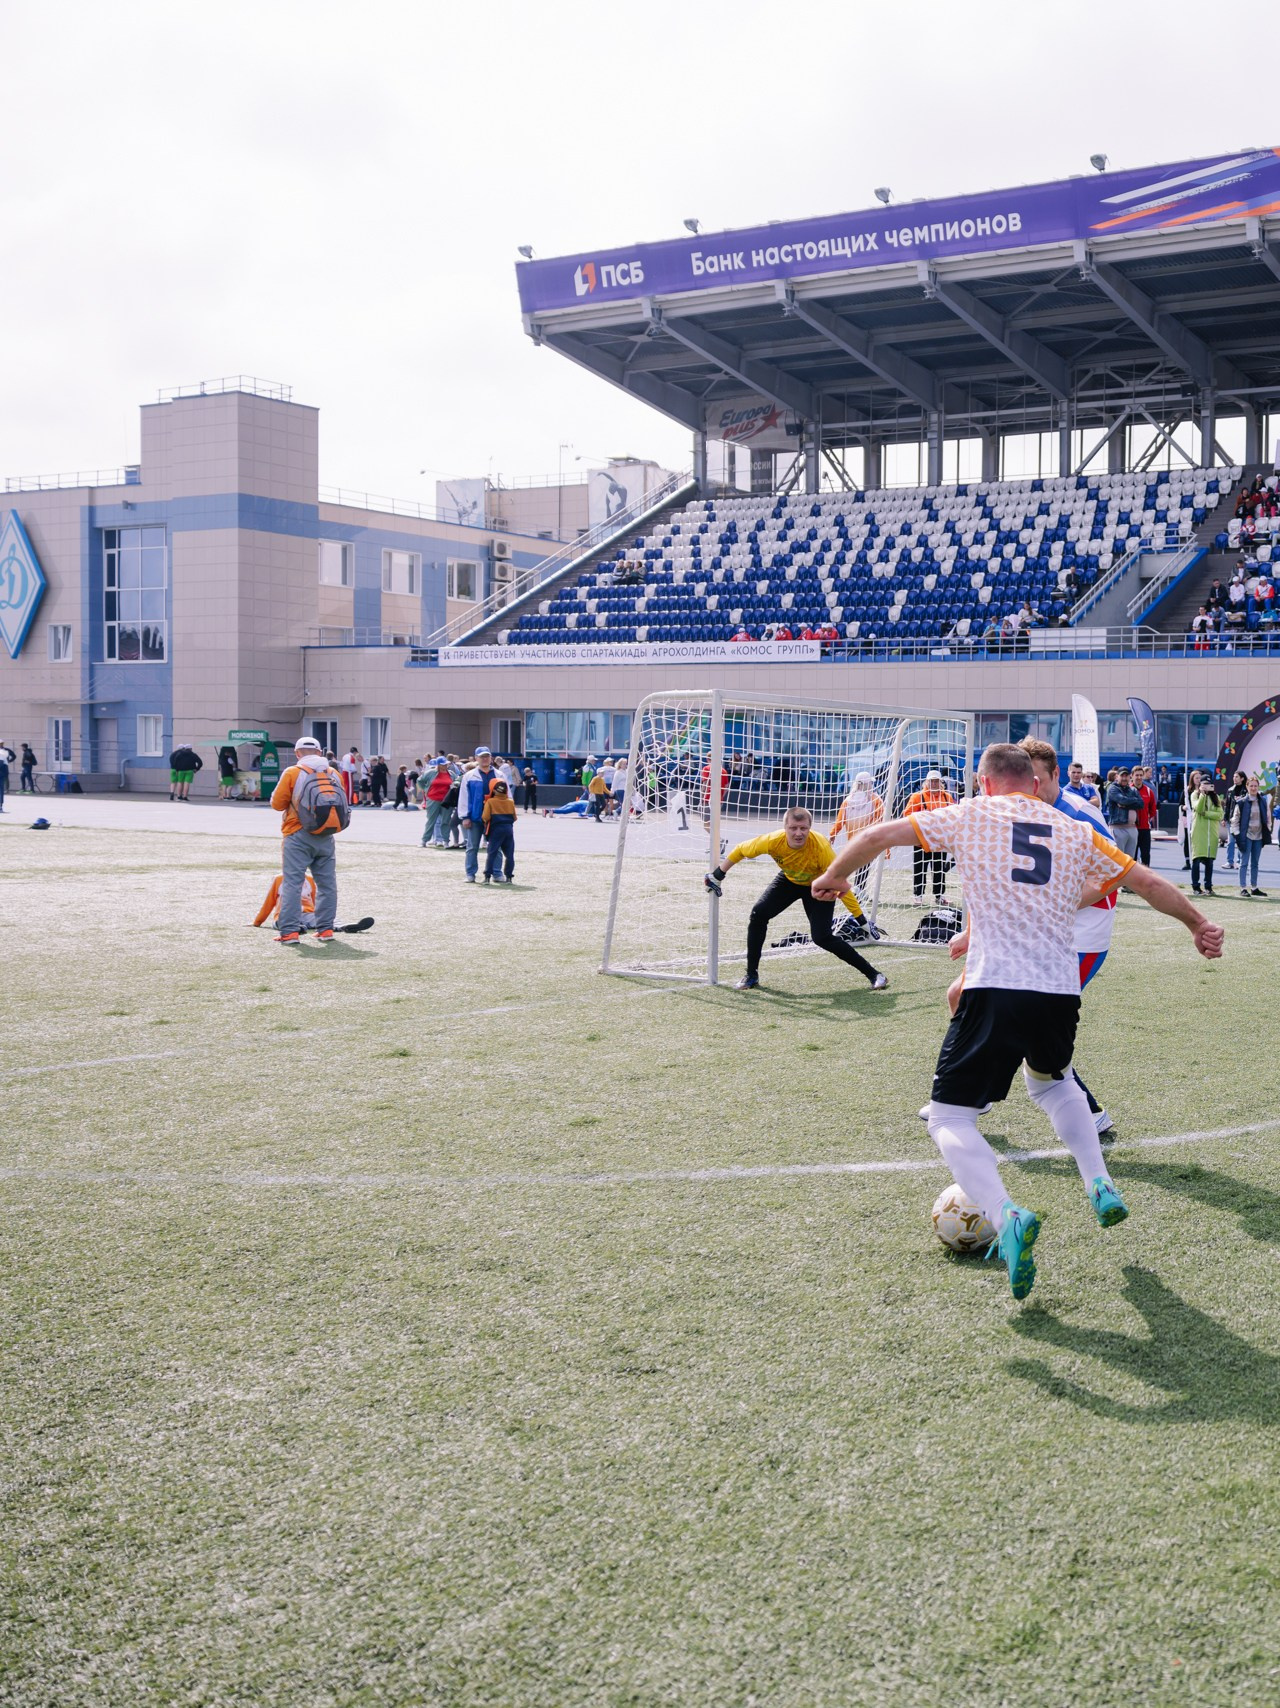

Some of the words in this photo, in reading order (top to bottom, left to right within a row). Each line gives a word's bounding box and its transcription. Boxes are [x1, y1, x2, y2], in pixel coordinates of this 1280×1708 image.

[690, 251, 746, 276] Банк
[751, 232, 879, 268] настоящих
[884, 212, 1022, 248] чемпионов
[600, 260, 644, 288] ПСБ
[453, 650, 516, 660] ПРИВЕТСТВУЕМ
[520, 648, 577, 659] УЧАСТНИКОВ
[580, 647, 648, 659] СПАРТАКИАДЫ
[652, 646, 726, 658] АГРОХОЛДИНГА
[730, 645, 772, 656] «КОМОС
[777, 644, 815, 656] ГРУПП»
[1011, 821, 1052, 885] 5
